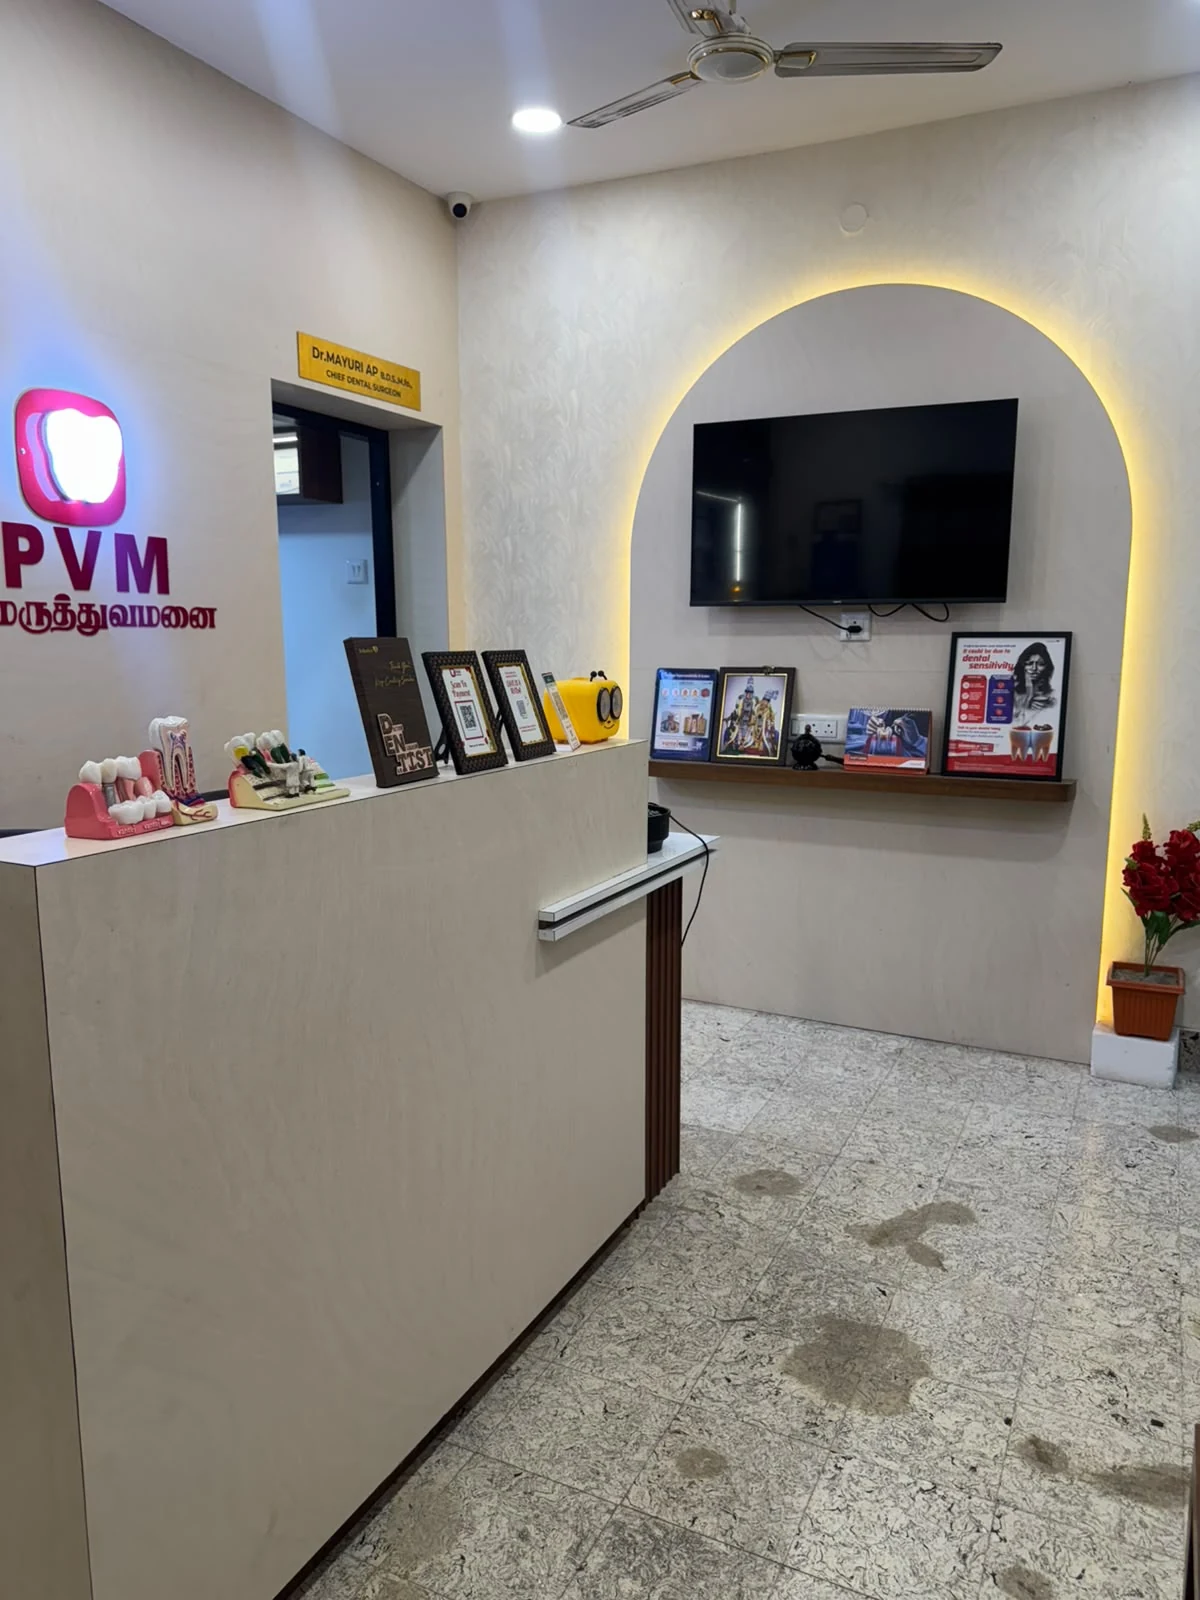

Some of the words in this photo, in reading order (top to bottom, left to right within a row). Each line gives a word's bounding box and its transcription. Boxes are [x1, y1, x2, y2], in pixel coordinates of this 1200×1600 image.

[312, 346, 363, 373] Dr.MAYURI
[366, 364, 379, 377] AP
[326, 369, 346, 382] CHIEF
[346, 375, 371, 390] DENTAL
[372, 383, 401, 398] SURGEON
[1, 521, 170, 596] PVM
[0, 593, 217, 637] மருத்துவமனை
[962, 654, 991, 662] dental
[968, 661, 1015, 671] sensitivity
